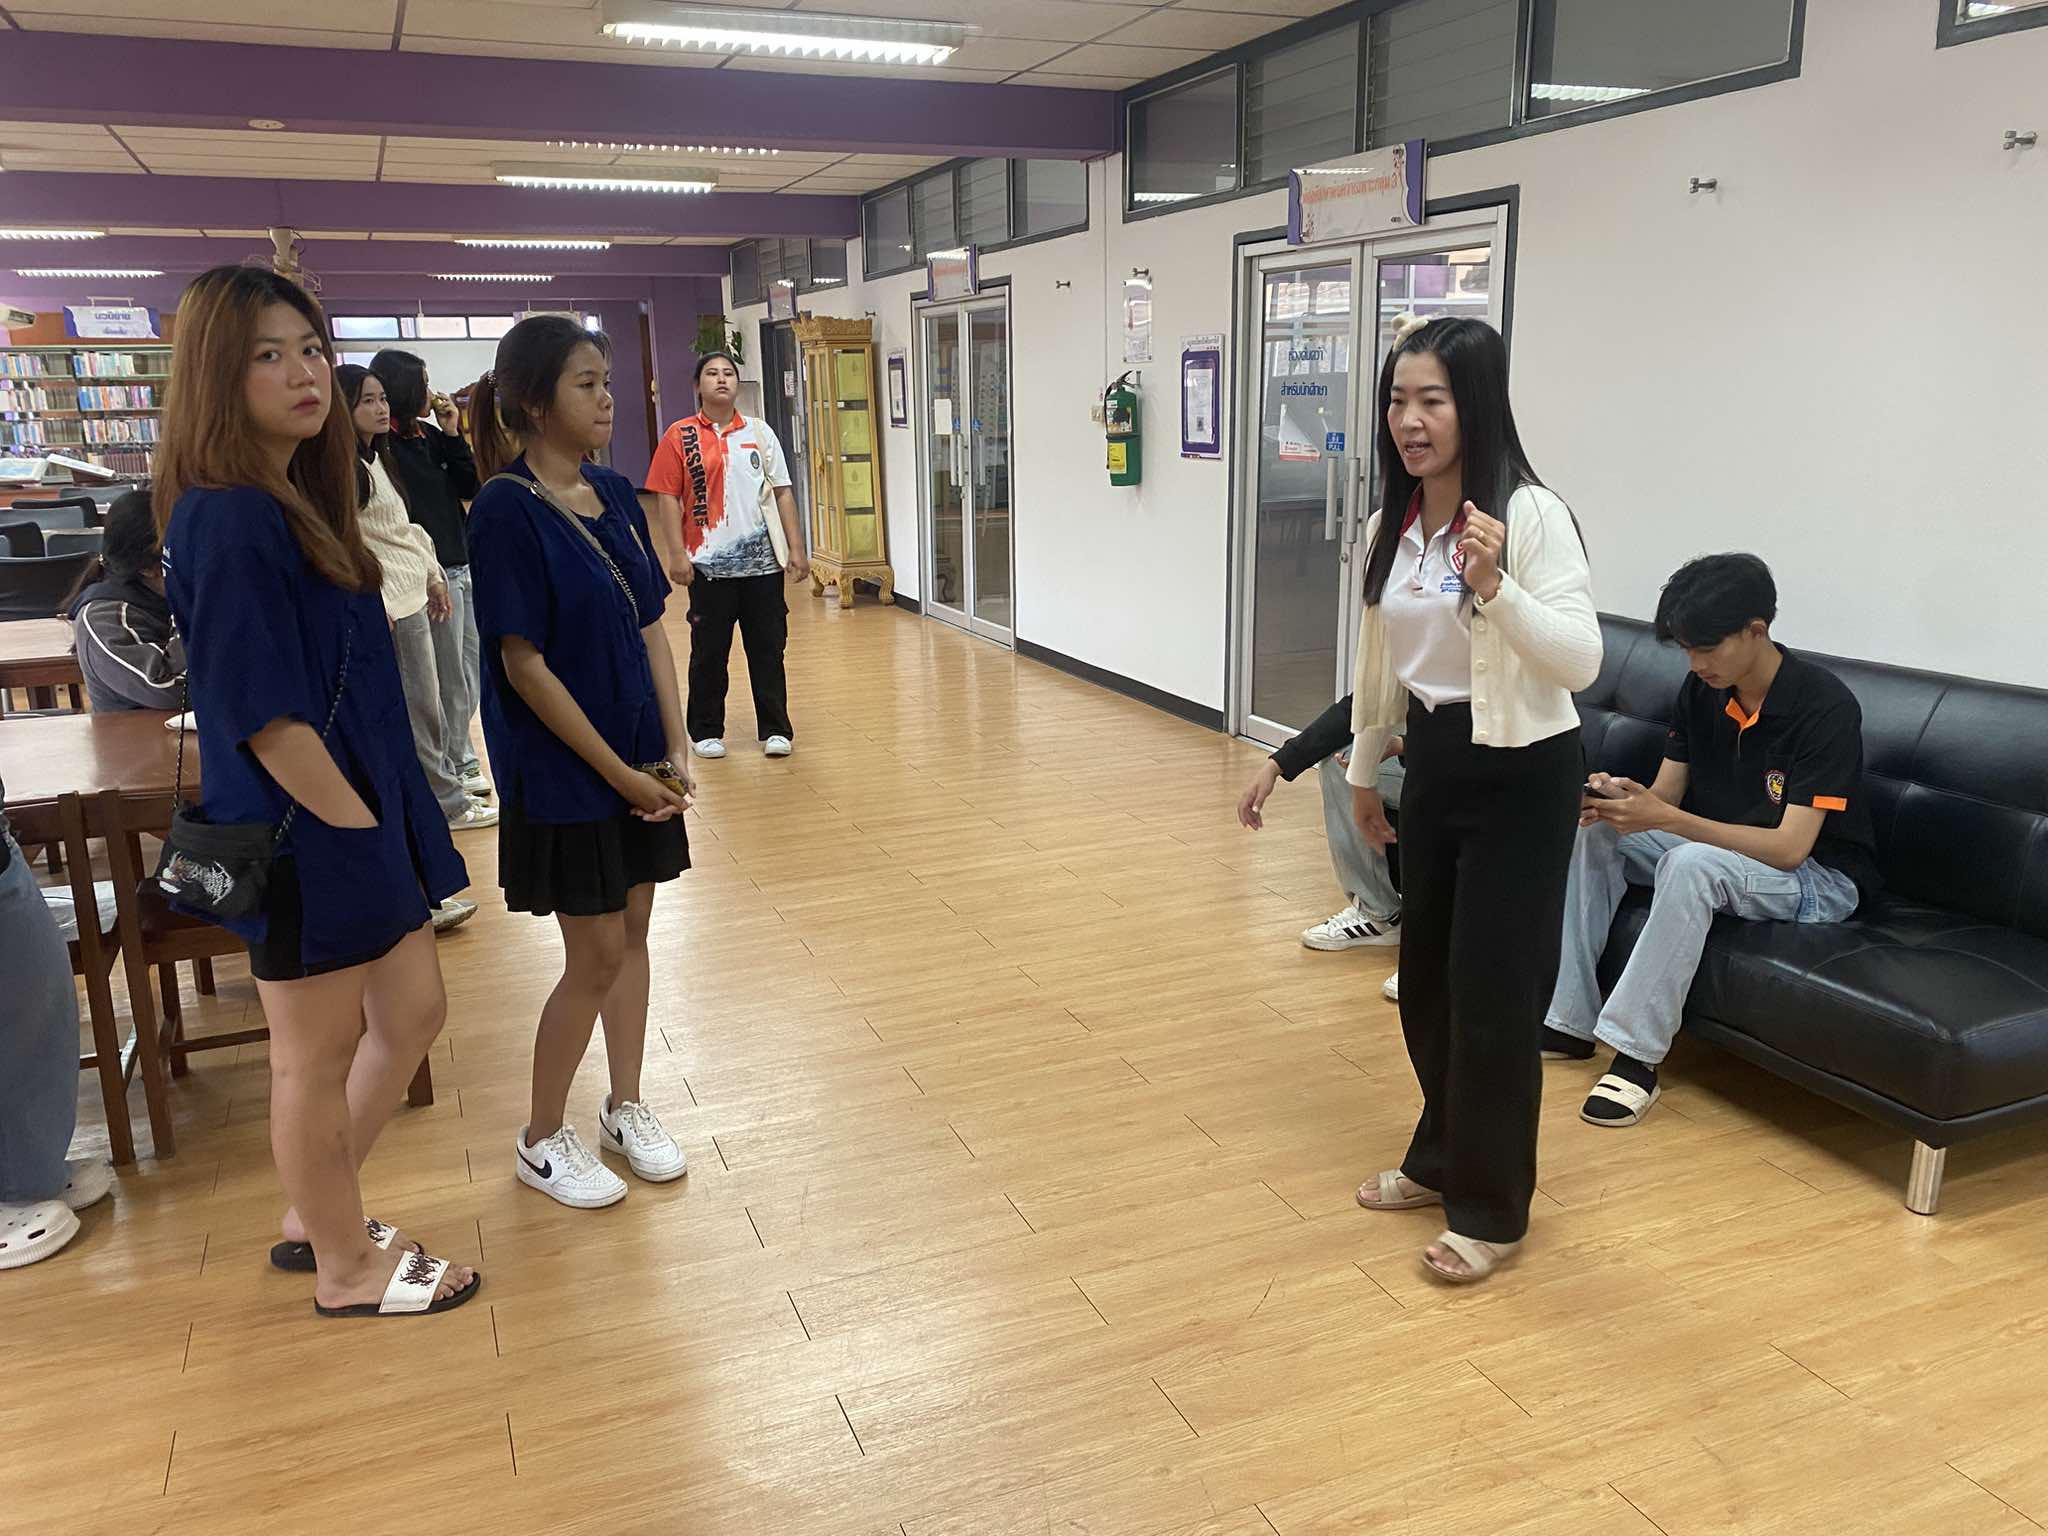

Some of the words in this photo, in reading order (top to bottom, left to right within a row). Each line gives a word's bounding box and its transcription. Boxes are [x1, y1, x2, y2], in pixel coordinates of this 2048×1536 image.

[1280, 381, 1328, 396] สำหรับนักศึกษา
[679, 425, 709, 516] FRESHMEN
